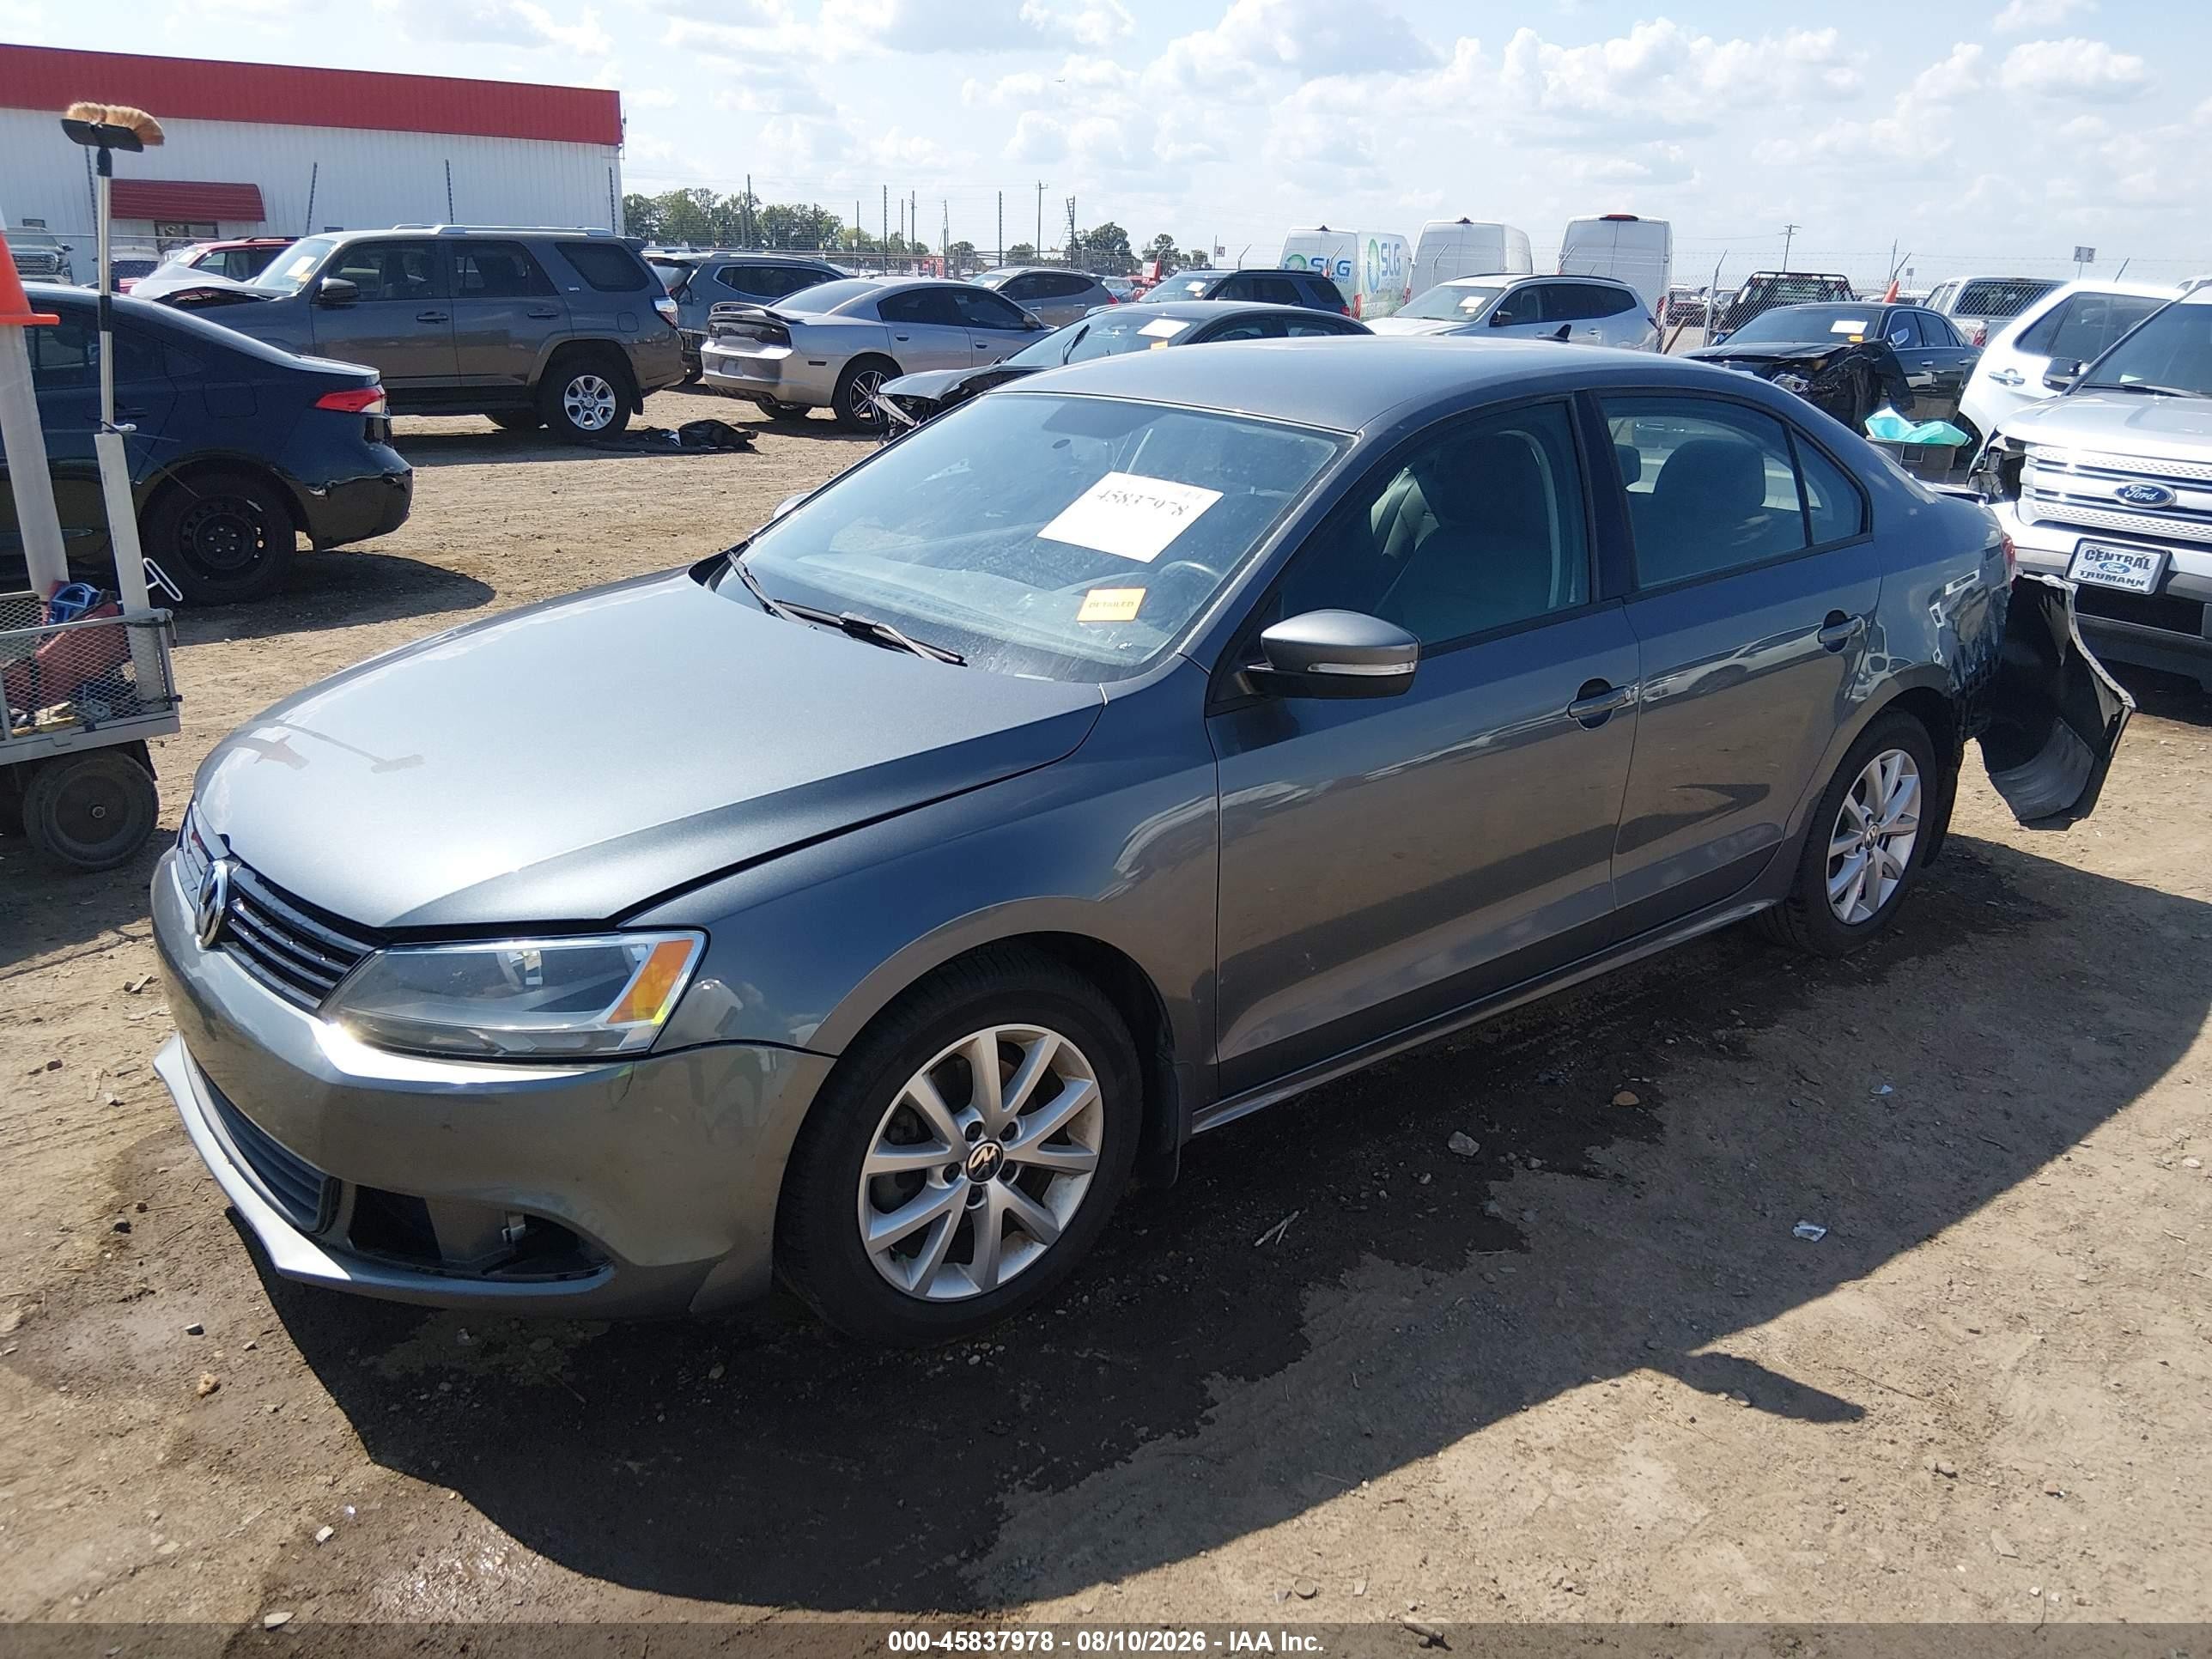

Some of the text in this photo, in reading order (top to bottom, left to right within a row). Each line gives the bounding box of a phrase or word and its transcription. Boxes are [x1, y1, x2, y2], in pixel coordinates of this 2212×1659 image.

[1380, 242, 1401, 276] SLG
[2124, 485, 2159, 501] Ford
[2084, 549, 2151, 570] CENTRAL
[2078, 569, 2145, 587] TRUMANN
